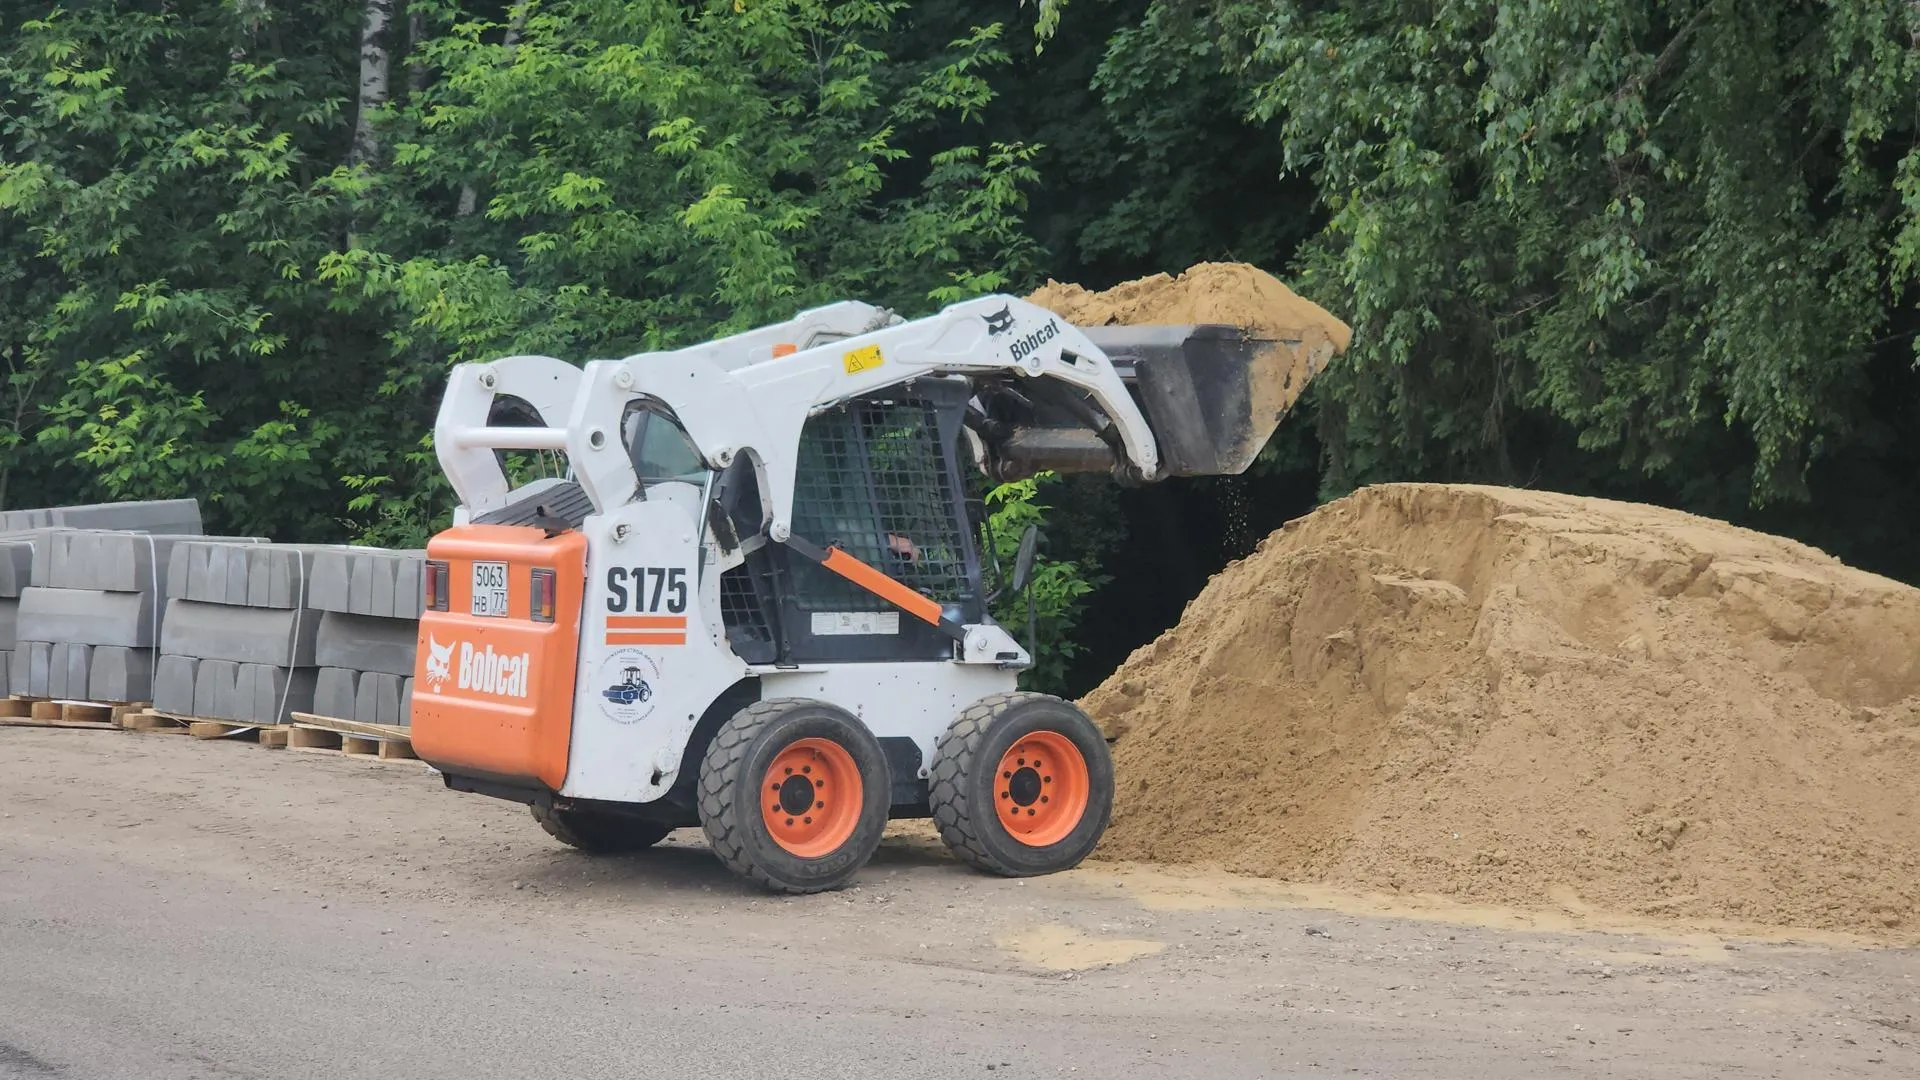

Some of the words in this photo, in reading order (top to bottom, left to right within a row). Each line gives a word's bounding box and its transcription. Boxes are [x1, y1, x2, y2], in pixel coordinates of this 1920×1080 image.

[1009, 318, 1060, 362] Bobcat
[476, 565, 503, 587] 5063
[606, 566, 687, 614] S175
[494, 592, 504, 609] 77
[458, 641, 529, 698] Bobcat
